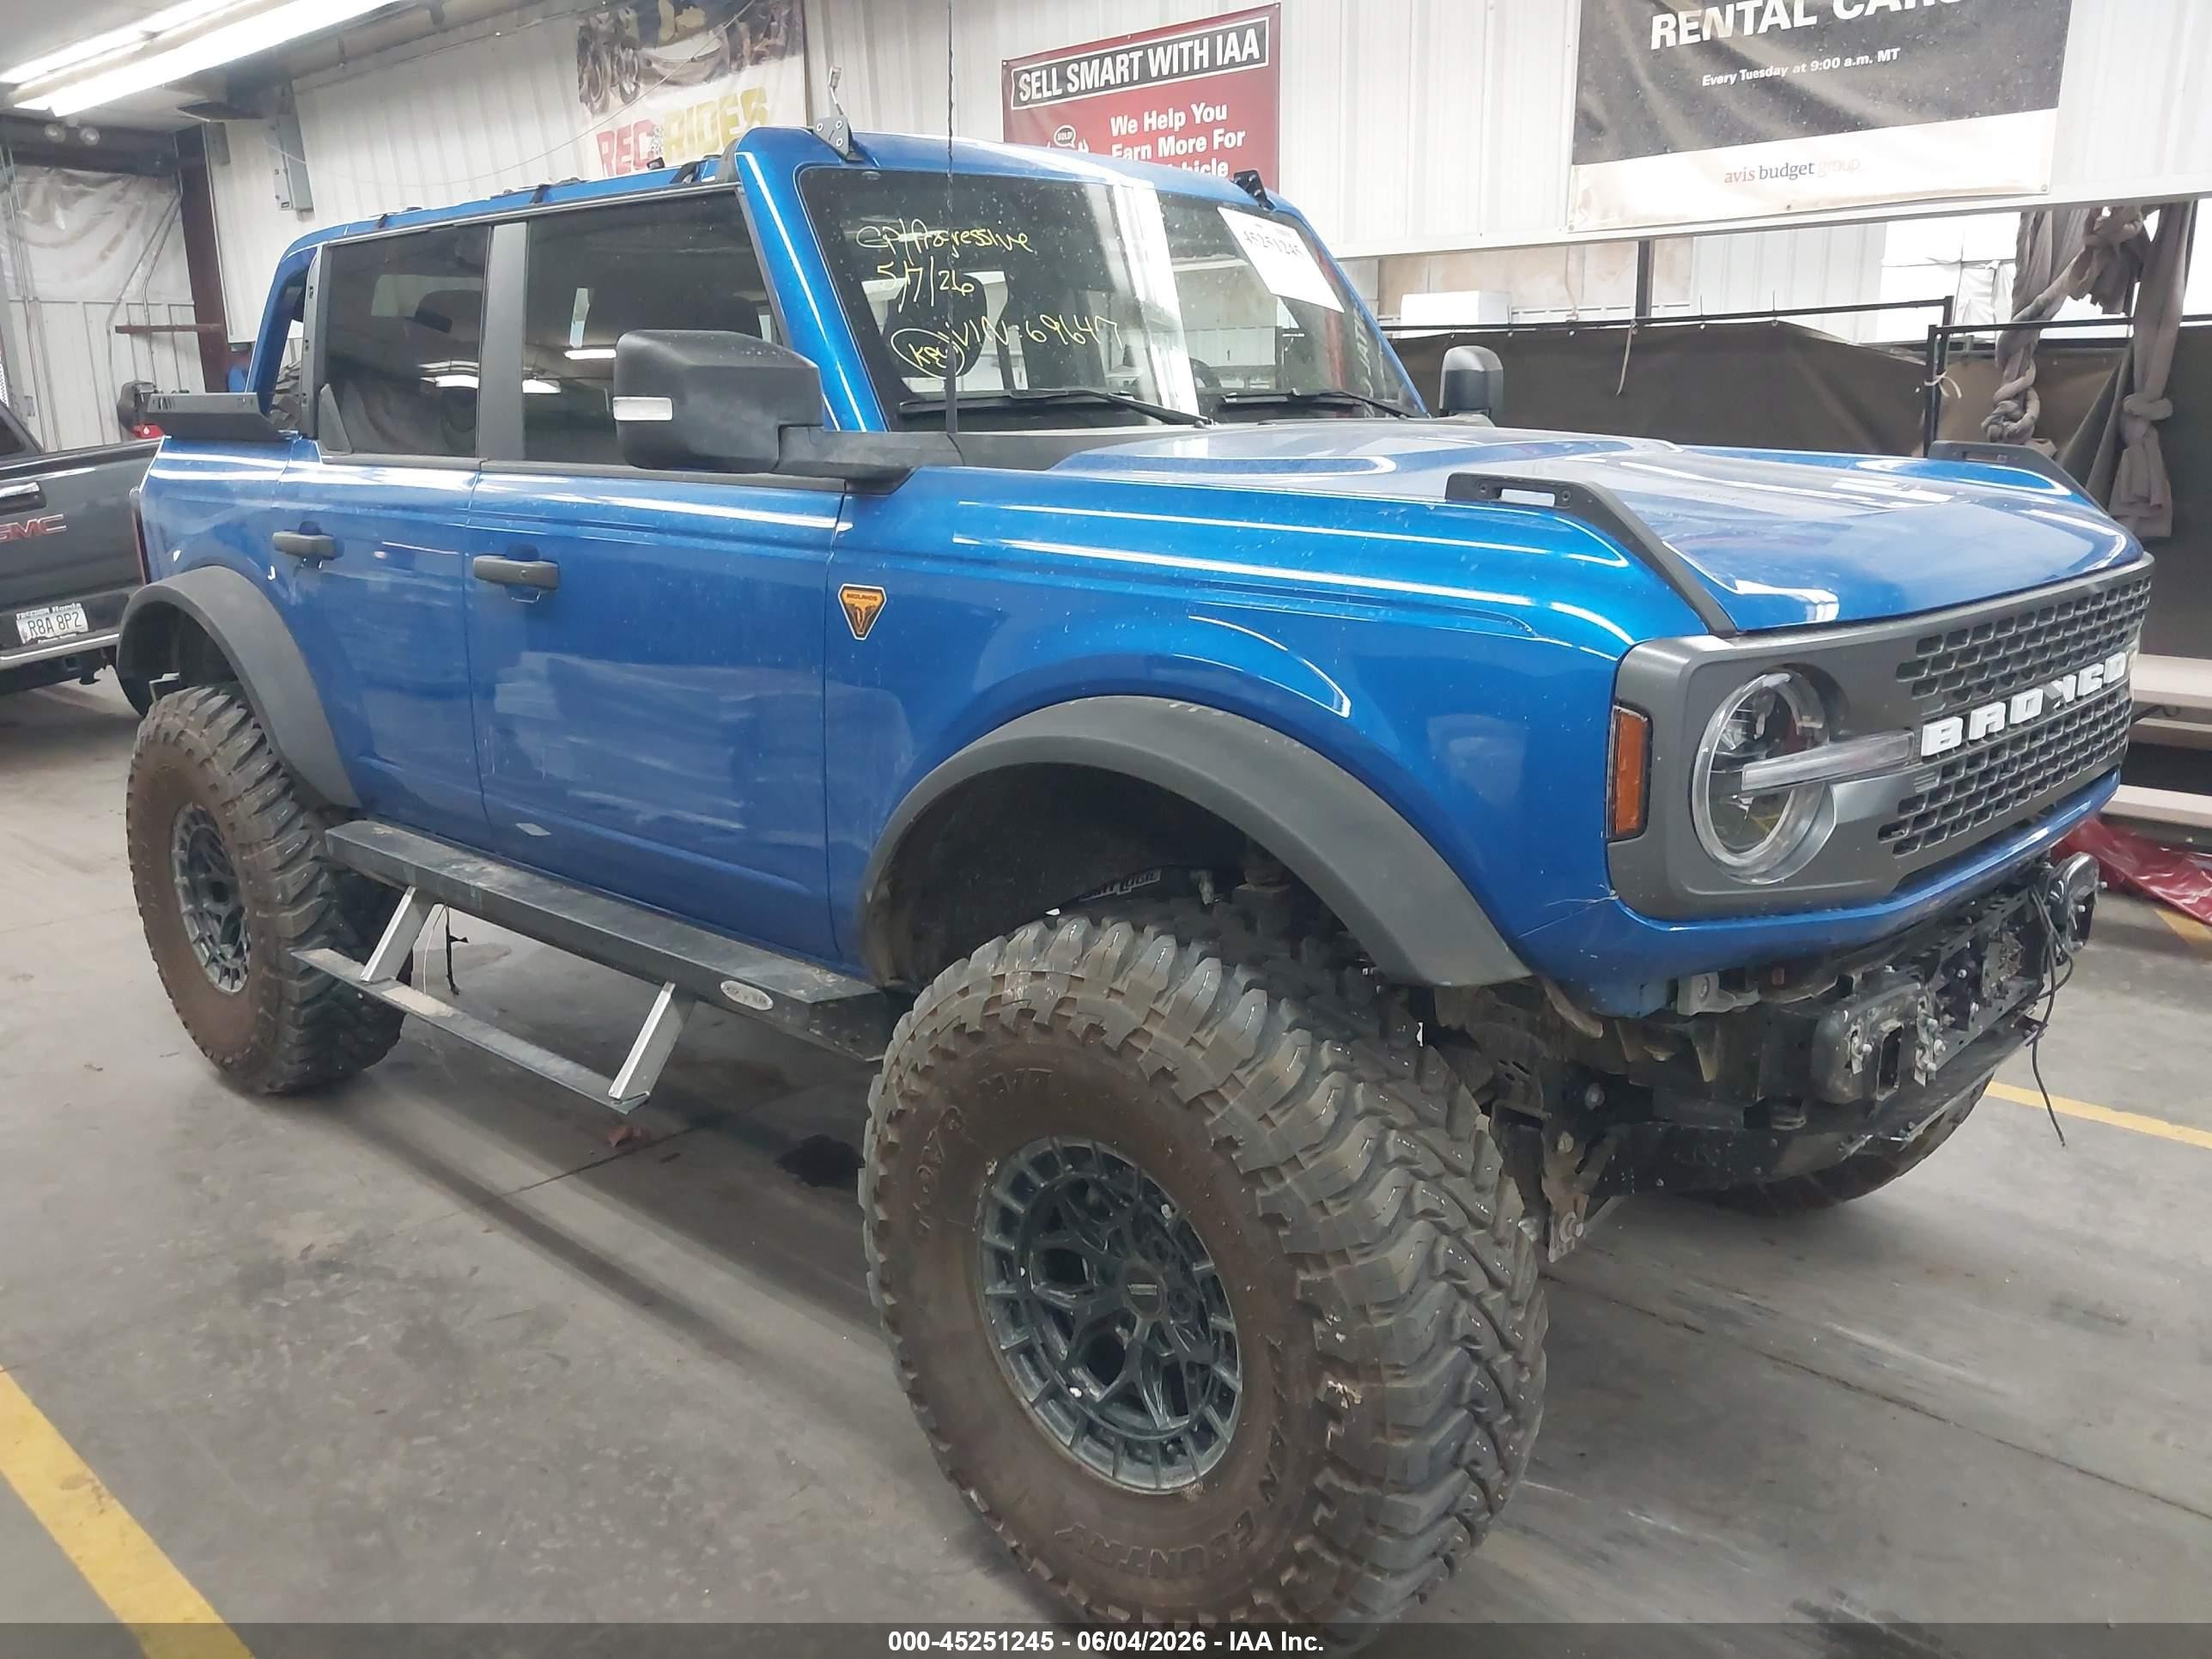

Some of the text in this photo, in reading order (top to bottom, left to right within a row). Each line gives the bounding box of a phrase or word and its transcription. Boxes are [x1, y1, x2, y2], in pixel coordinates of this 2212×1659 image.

[1650, 0, 1818, 50] RENTAL
[1018, 27, 1260, 101] SELL SMART WITH IAA
[1702, 47, 1901, 87] Every Tuesday at 9:00 a.m. MT
[1110, 102, 1228, 137] We Help You
[1111, 128, 1246, 161] Earn More For
[1724, 167, 1756, 184] avis
[1759, 161, 1815, 180] budget
[27, 611, 83, 638] R8A 8P2
